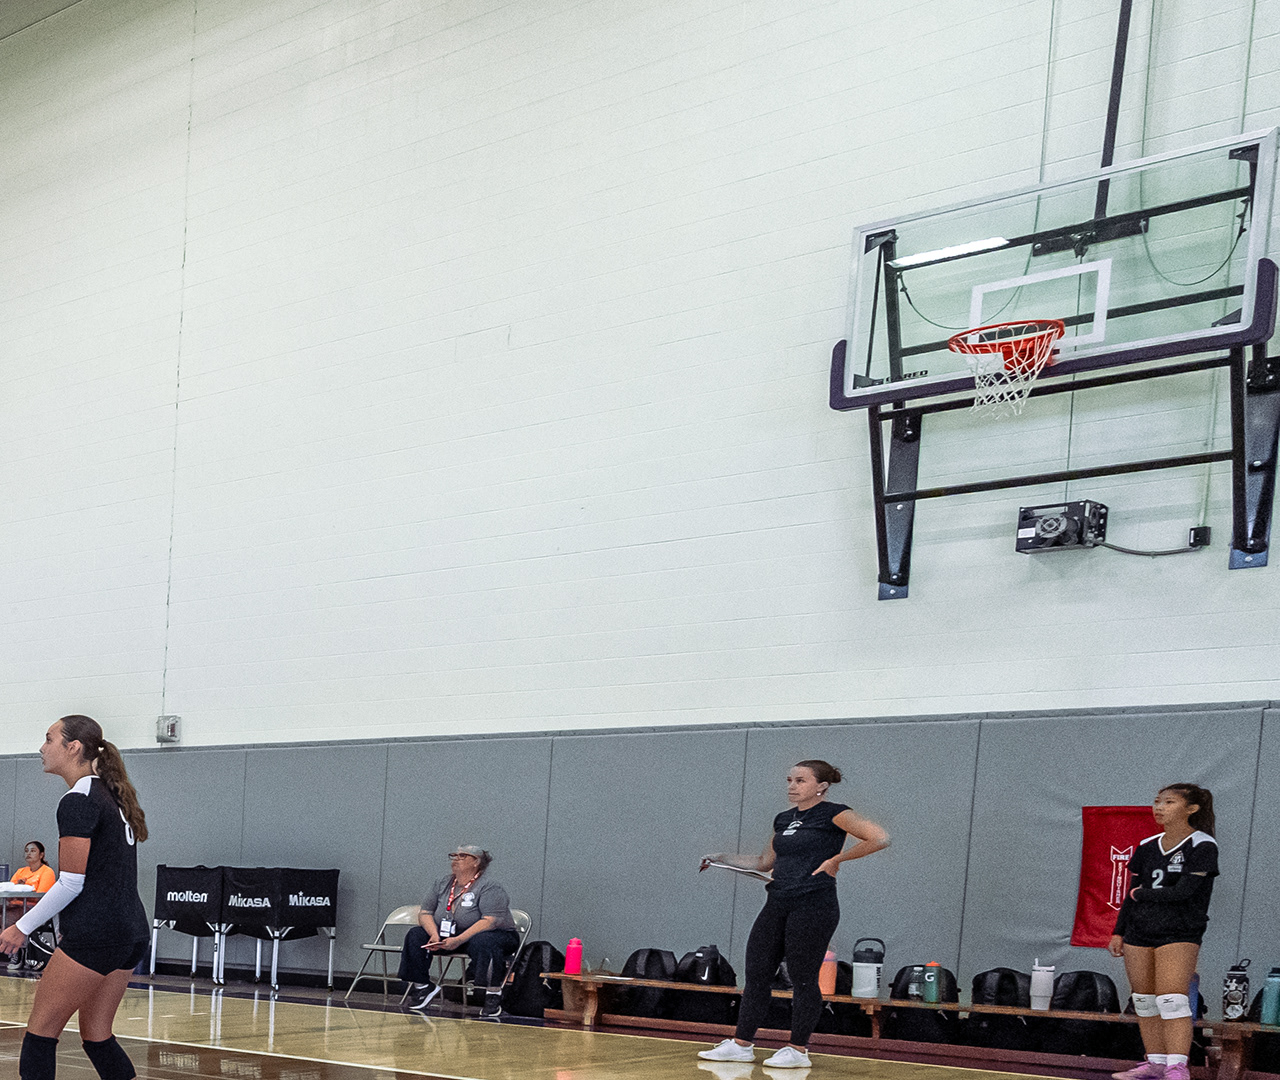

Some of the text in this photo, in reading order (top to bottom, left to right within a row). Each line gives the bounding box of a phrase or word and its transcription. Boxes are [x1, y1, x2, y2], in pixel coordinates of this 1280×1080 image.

[1151, 868, 1164, 889] 2
[167, 890, 209, 903] molten
[924, 972, 935, 982] G
